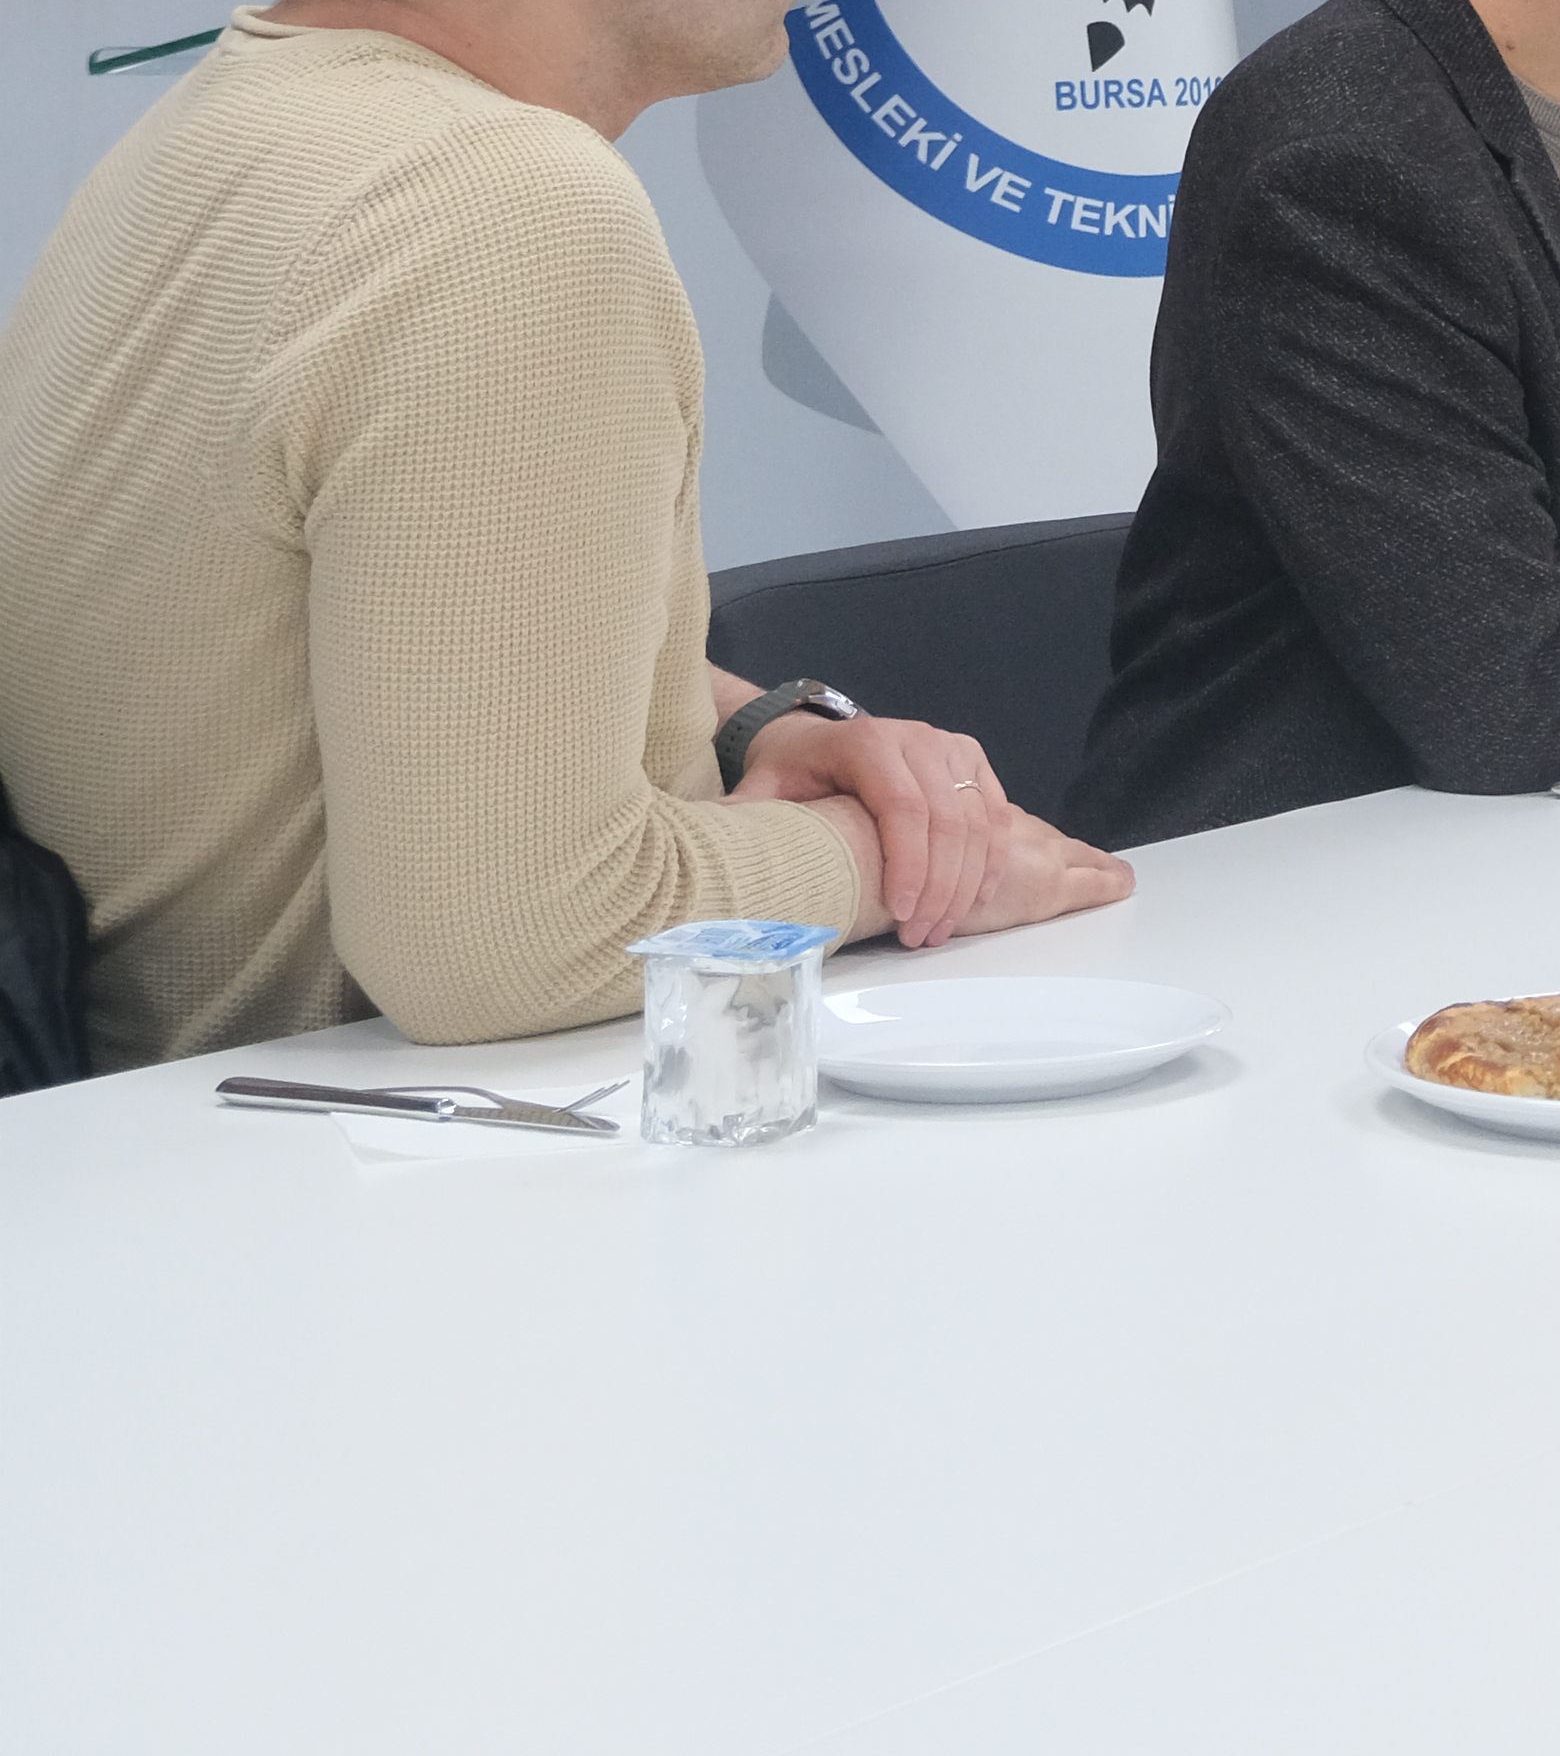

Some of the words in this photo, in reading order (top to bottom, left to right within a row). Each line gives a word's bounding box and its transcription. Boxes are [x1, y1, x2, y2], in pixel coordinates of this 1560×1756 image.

[804, 1, 963, 171] MESLEKİ
[965, 153, 1033, 213] VE
[1055, 77, 1168, 111] BURSA
